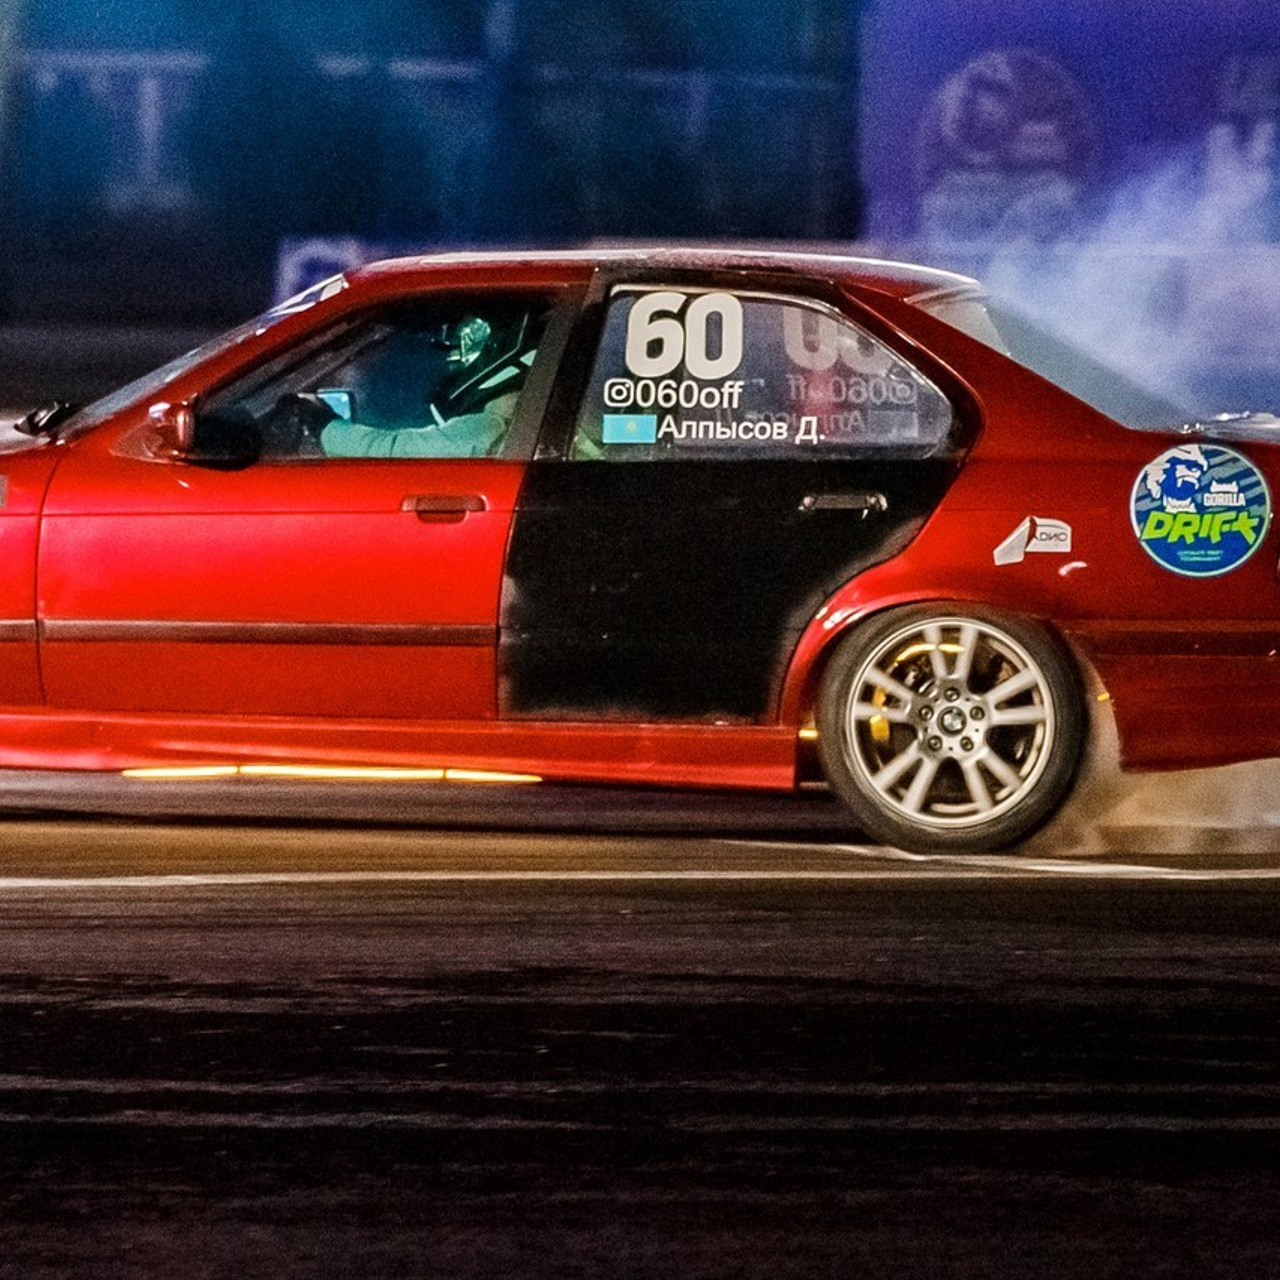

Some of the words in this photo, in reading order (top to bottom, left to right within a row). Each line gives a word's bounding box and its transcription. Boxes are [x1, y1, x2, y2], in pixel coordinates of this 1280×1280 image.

[625, 292, 743, 379] 60
[636, 379, 745, 409] 060off
[657, 414, 788, 440] Алпысов
[795, 416, 826, 445] Д.
[1203, 493, 1246, 507] GORILLA
[1141, 511, 1260, 545] DRIFT
